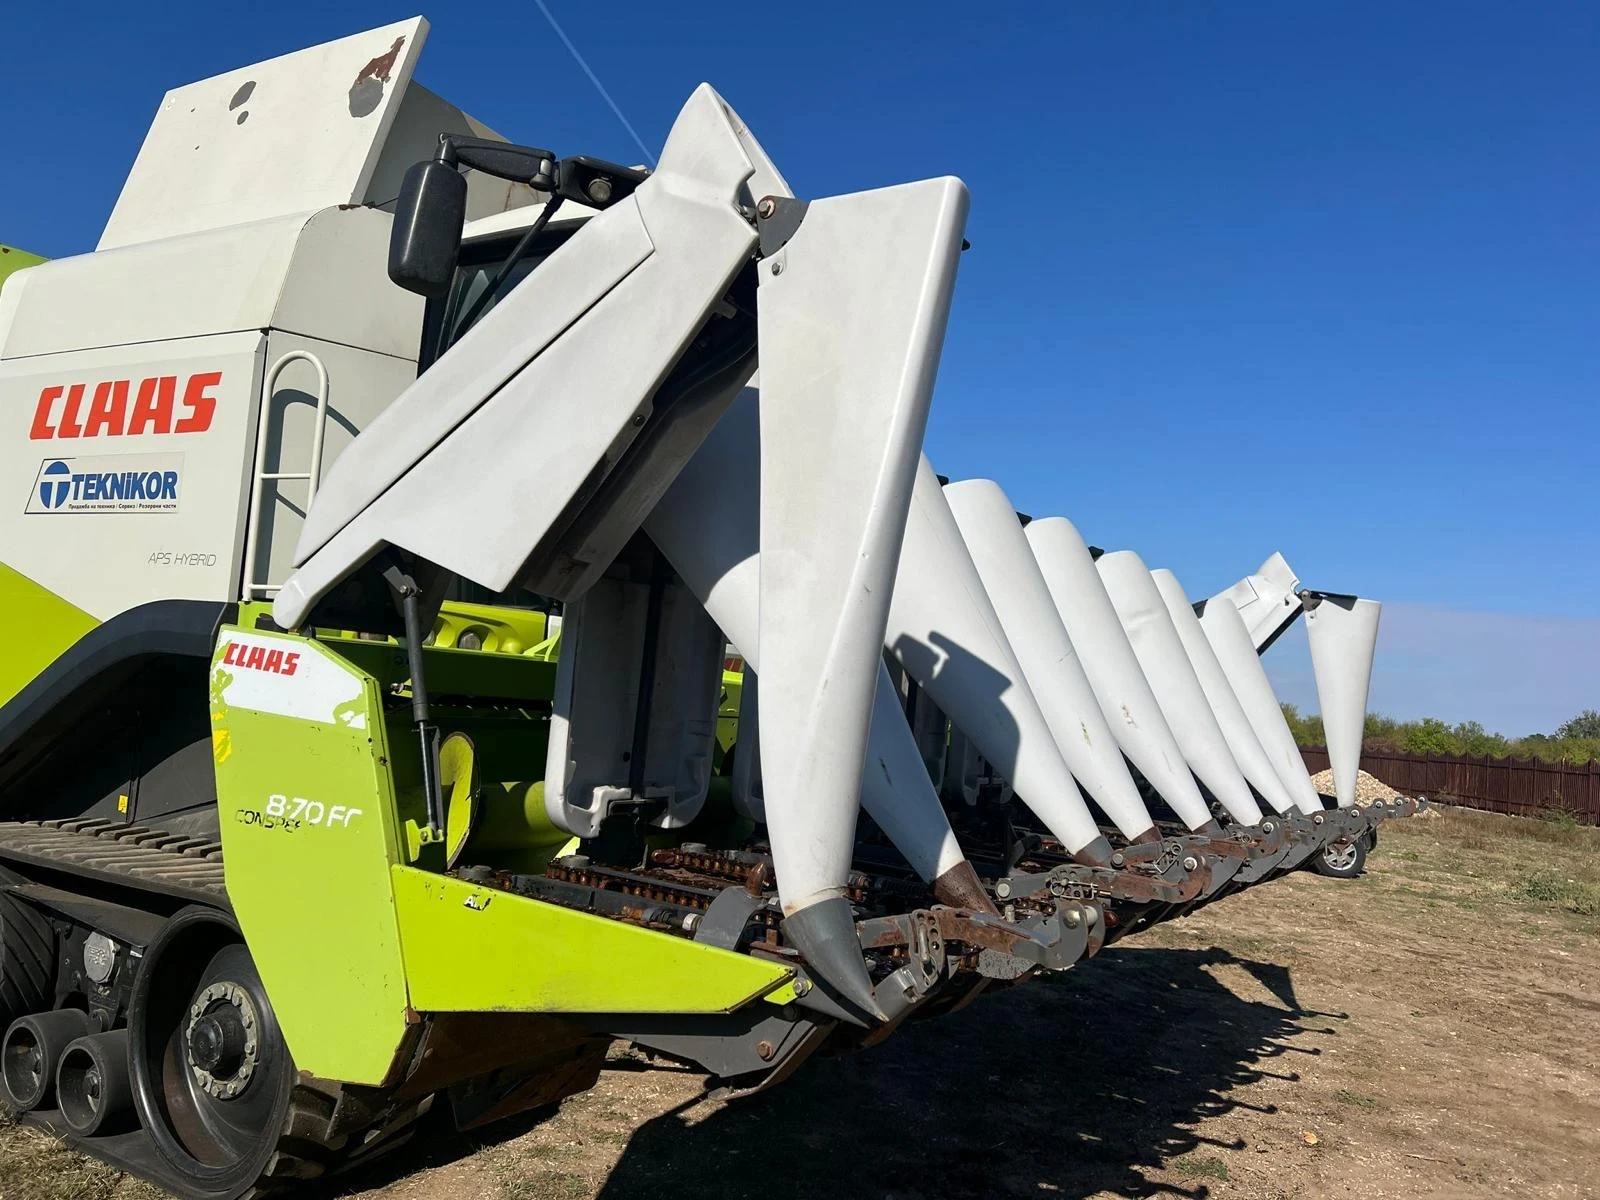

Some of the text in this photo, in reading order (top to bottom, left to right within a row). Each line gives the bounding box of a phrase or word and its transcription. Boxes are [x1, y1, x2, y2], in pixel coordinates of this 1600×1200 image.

[29, 371, 223, 440] CLAAS
[148, 552, 217, 566] APS HYBRID
[223, 643, 300, 676] CLAAS
